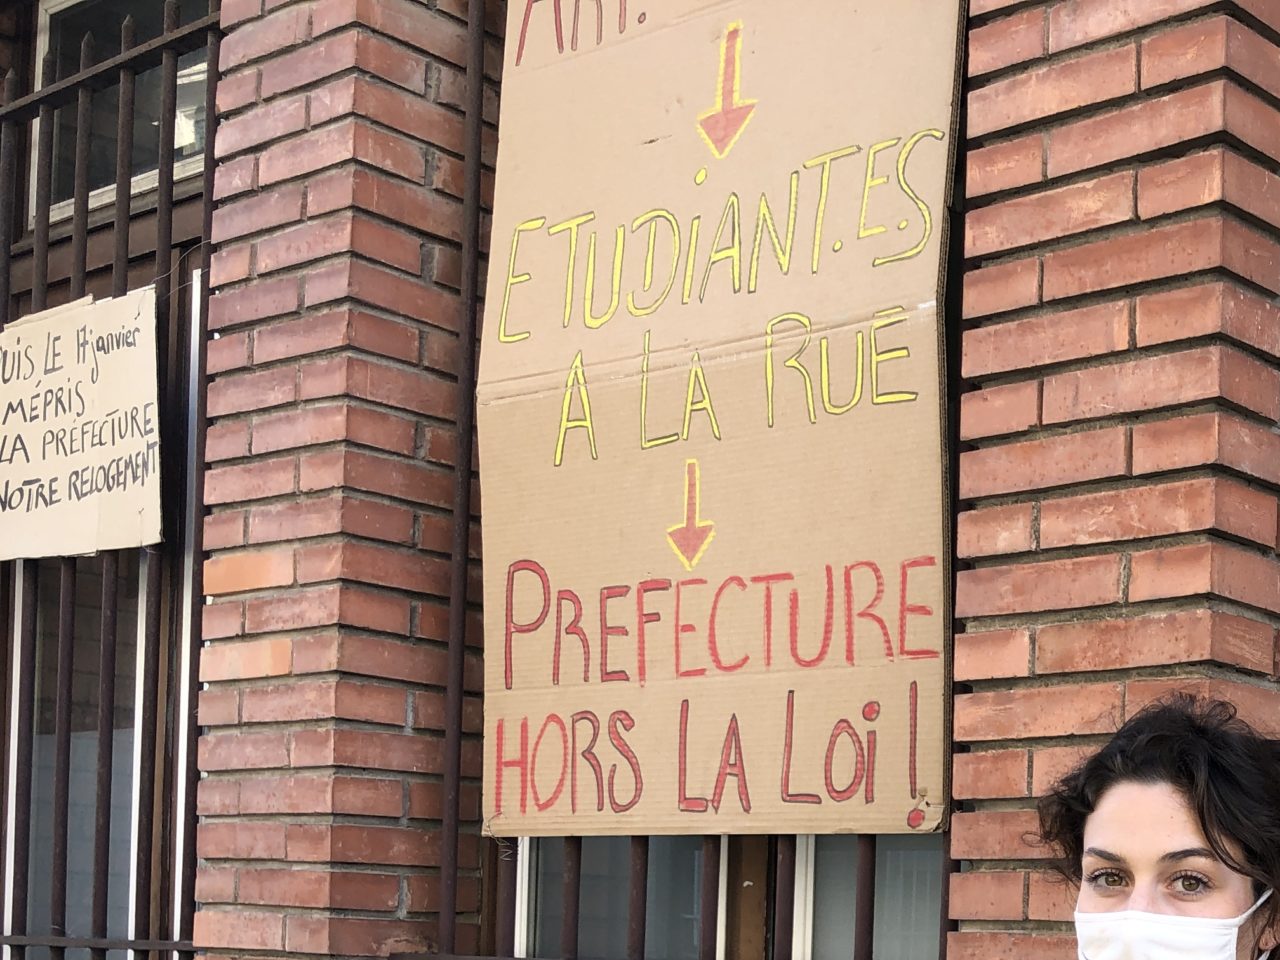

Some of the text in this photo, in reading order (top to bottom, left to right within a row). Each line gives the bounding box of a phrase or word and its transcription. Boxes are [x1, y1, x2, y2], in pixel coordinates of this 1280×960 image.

[0, 337, 35, 384] UiS
[43, 331, 64, 376] LE
[553, 306, 918, 466] A LA RUE
[42, 402, 155, 461] PRÉFECTURE
[68, 440, 159, 502] RELOGEMENT
[504, 556, 940, 690] PREFECTURE
[495, 709, 644, 815] HORS
[678, 698, 752, 815] LA
